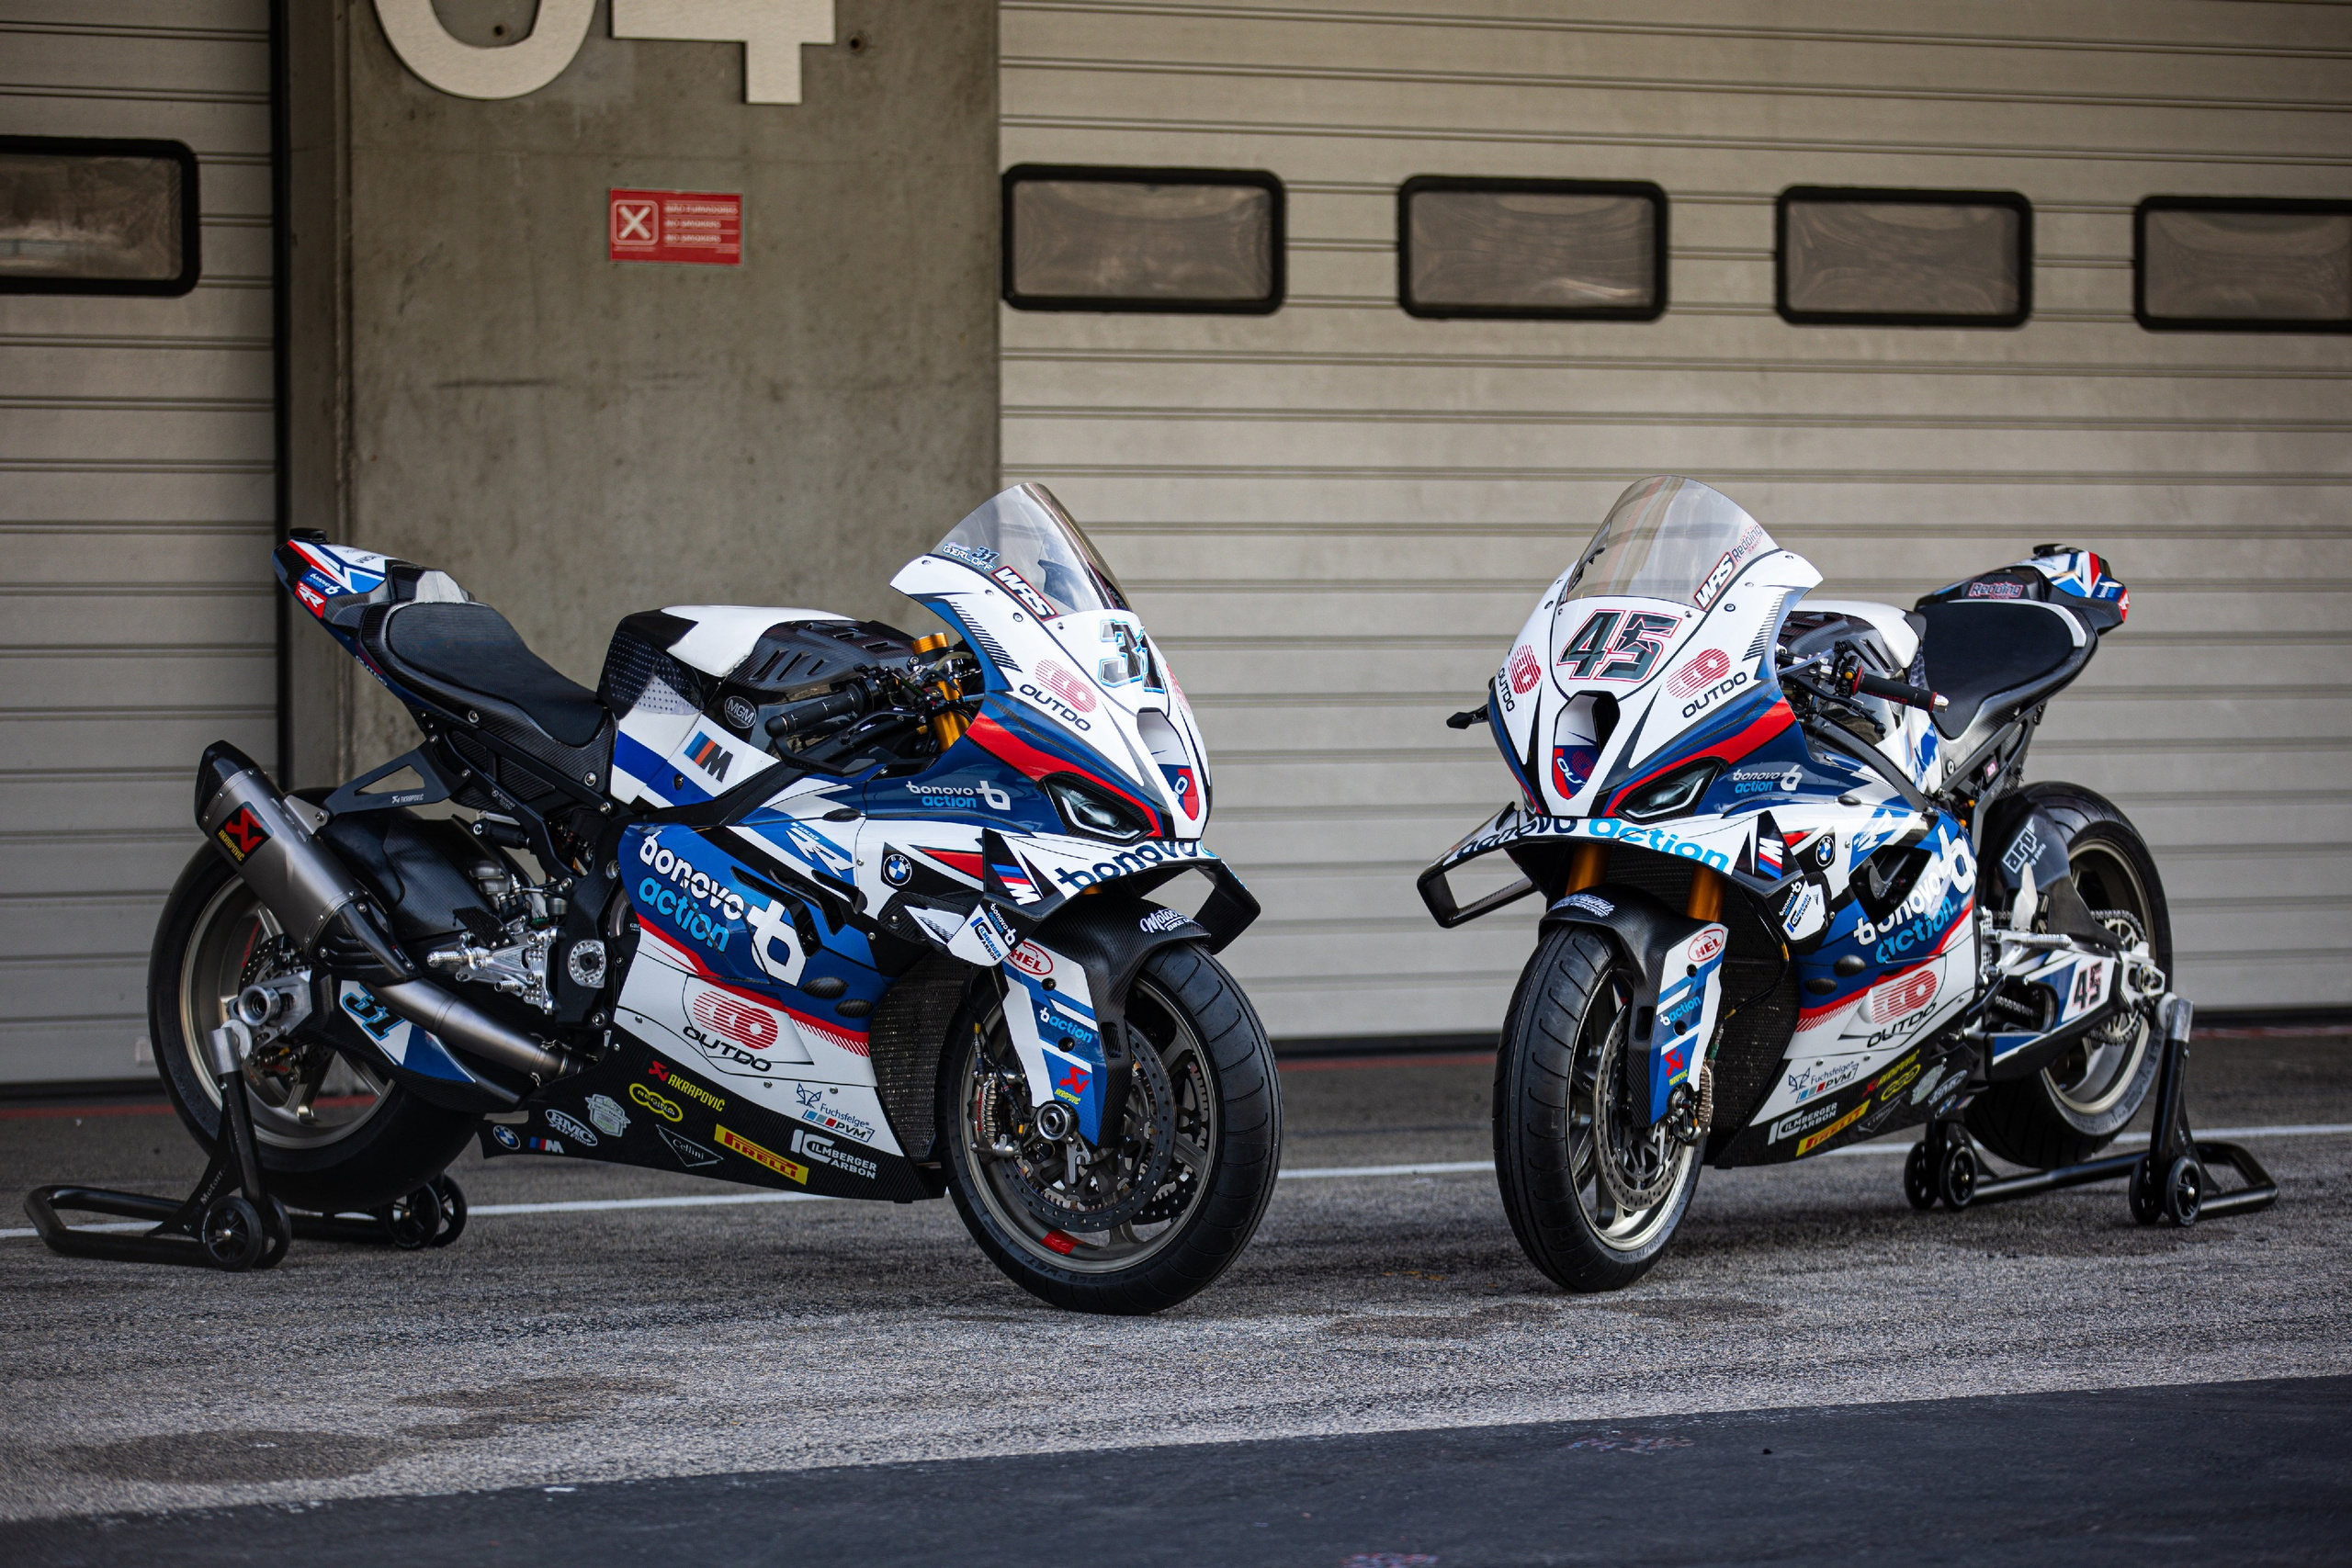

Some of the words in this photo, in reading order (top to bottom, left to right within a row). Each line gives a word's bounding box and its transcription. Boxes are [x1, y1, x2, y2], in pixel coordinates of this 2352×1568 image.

[943, 546, 994, 570] GERLOFF
[994, 567, 1056, 616] WRS
[1696, 553, 1733, 608] WRS
[1098, 619, 1165, 694] 31
[1556, 609, 1683, 682] 45
[1020, 684, 1091, 731] OUTDO
[1498, 668, 1515, 713] OUTDO
[1682, 671, 1747, 719] OUTDO
[728, 699, 754, 723] MGM
[906, 781, 974, 795] bonovo
[1733, 769, 1781, 781] bonovo
[1735, 781, 1773, 793] action
[922, 795, 977, 808] action
[1589, 818, 1729, 873] action
[640, 830, 744, 919] bonovo
[639, 877, 730, 952] action
[988, 911, 1004, 934] action
[989, 903, 1009, 930] bonovo
[1853, 872, 1940, 945] bonovo
[1695, 937, 1722, 959] HEL
[1876, 896, 1954, 964] action
[1011, 949, 1042, 973] HEL
[2072, 958, 2104, 1012] 45
[1668, 995, 1702, 1022] action
[1867, 1002, 1938, 1049] OUTDO
[1050, 1013, 1093, 1043] action
[683, 1026, 772, 1072] OUTDO
[668, 1074, 725, 1112] AKRAPOVIČ
[550, 1111, 593, 1143] BMC
[1784, 1102, 1838, 1131] ILMBERGER
[673, 1139, 704, 1159] Cellini
[724, 1131, 798, 1179] PIRELLI
[812, 1142, 877, 1171] ILMBERGER
